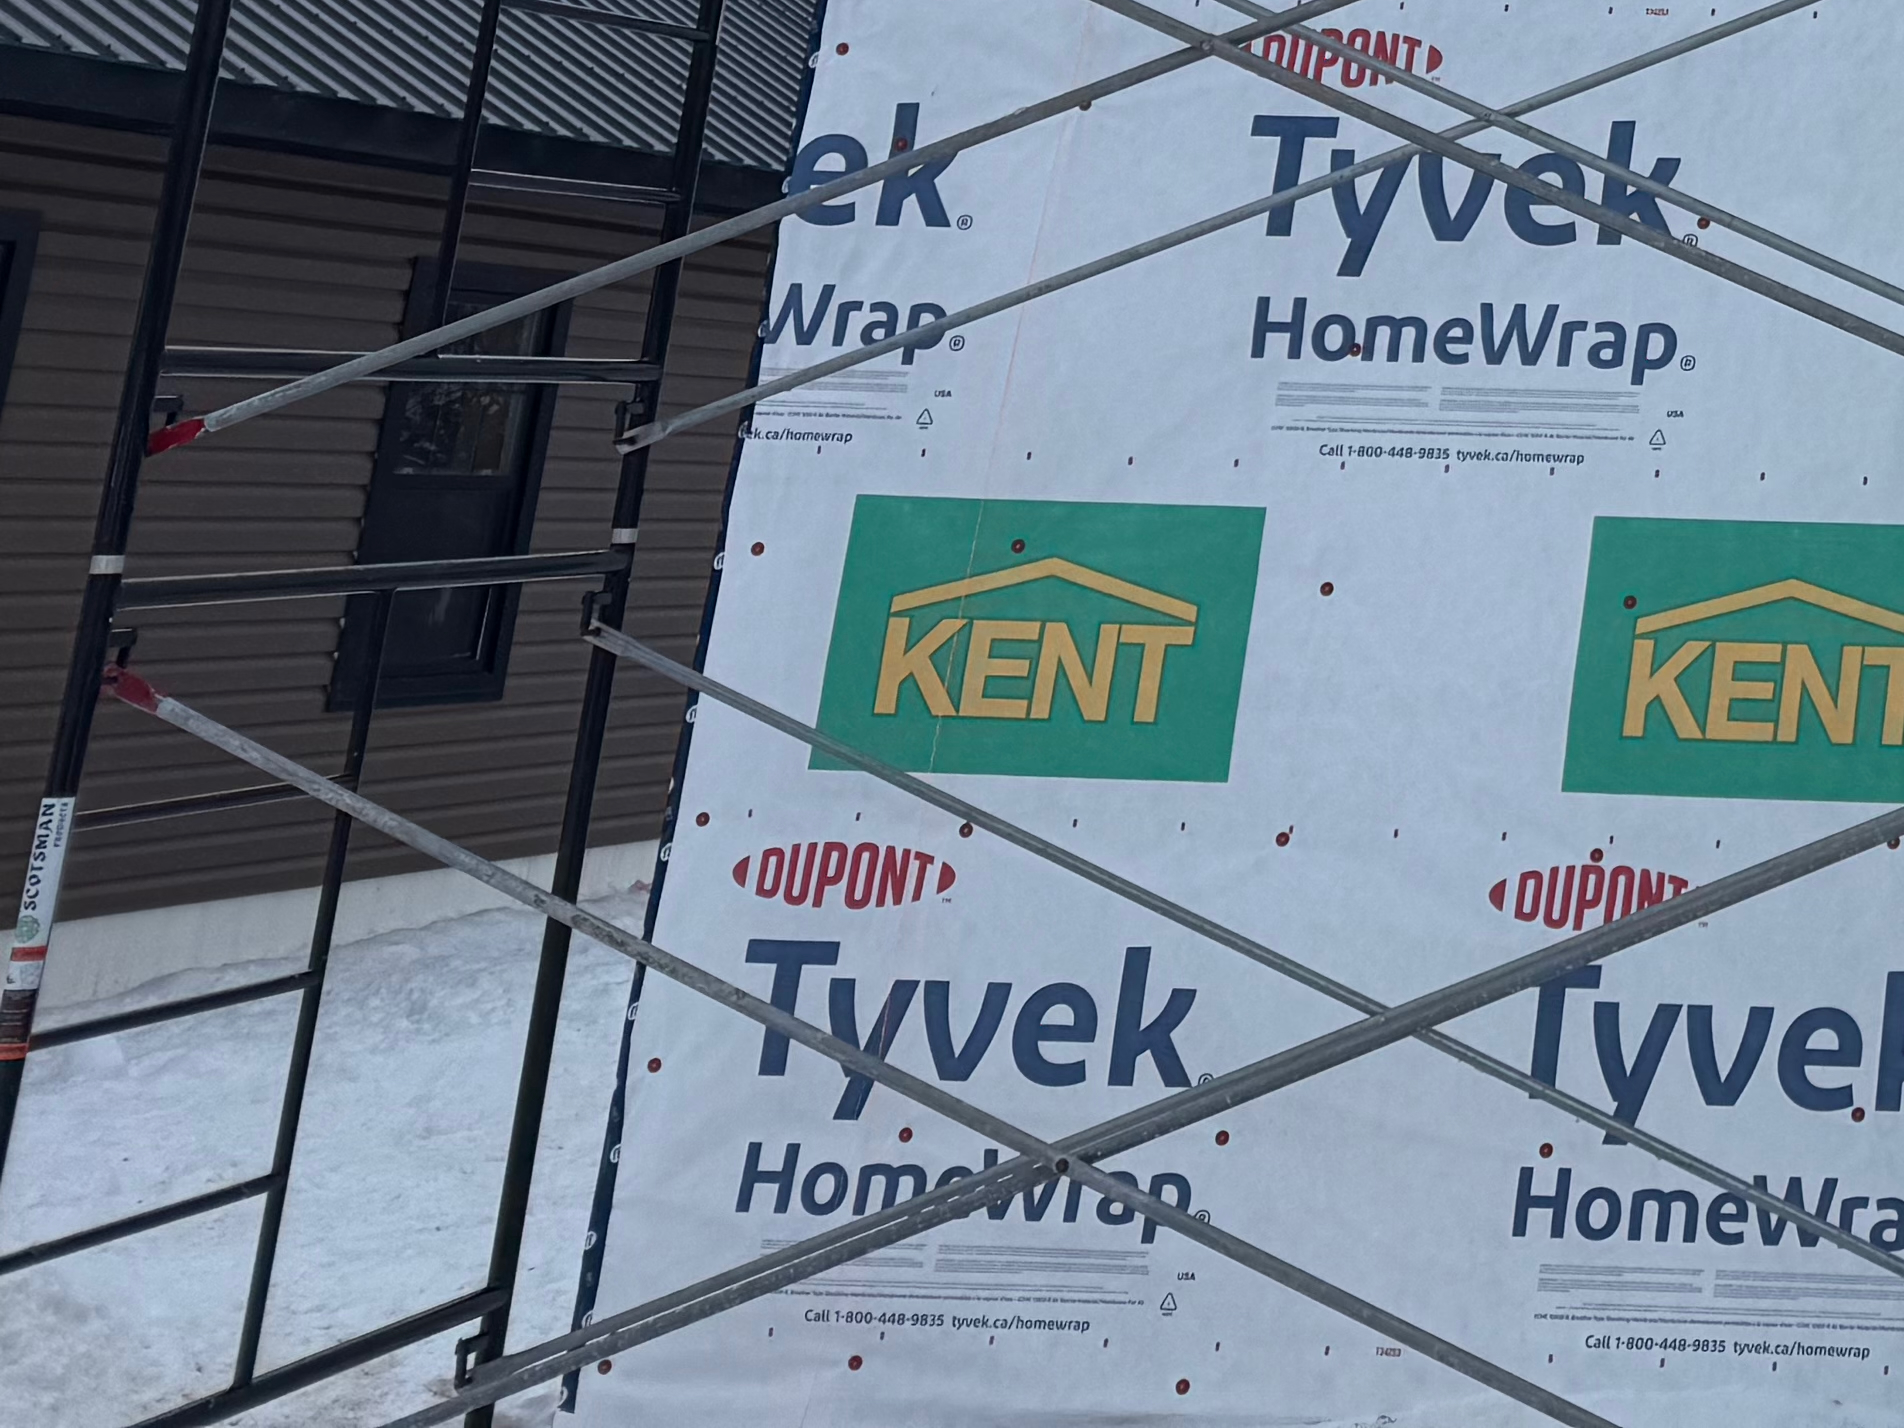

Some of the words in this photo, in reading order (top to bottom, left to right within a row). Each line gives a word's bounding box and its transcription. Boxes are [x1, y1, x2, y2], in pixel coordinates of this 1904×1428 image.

[1319, 444, 1344, 460] Call
[1347, 444, 1450, 462] 1-800-448-9835
[1455, 447, 1585, 467] tyvek.ca/homewrap
[872, 617, 1198, 724] KENT
[23, 802, 56, 911] SCOTSMAN
[755, 842, 935, 910] DUPONT
[804, 1308, 831, 1324] Call
[834, 1308, 946, 1328] 1-800-448-9835
[951, 1313, 1091, 1334] tyvek.ca/homewrap
[1585, 1334, 1611, 1351] Call
[1614, 1334, 1727, 1355] 1-800-448-9835
[1732, 1339, 1871, 1360] tyvek.ca/homewrap
